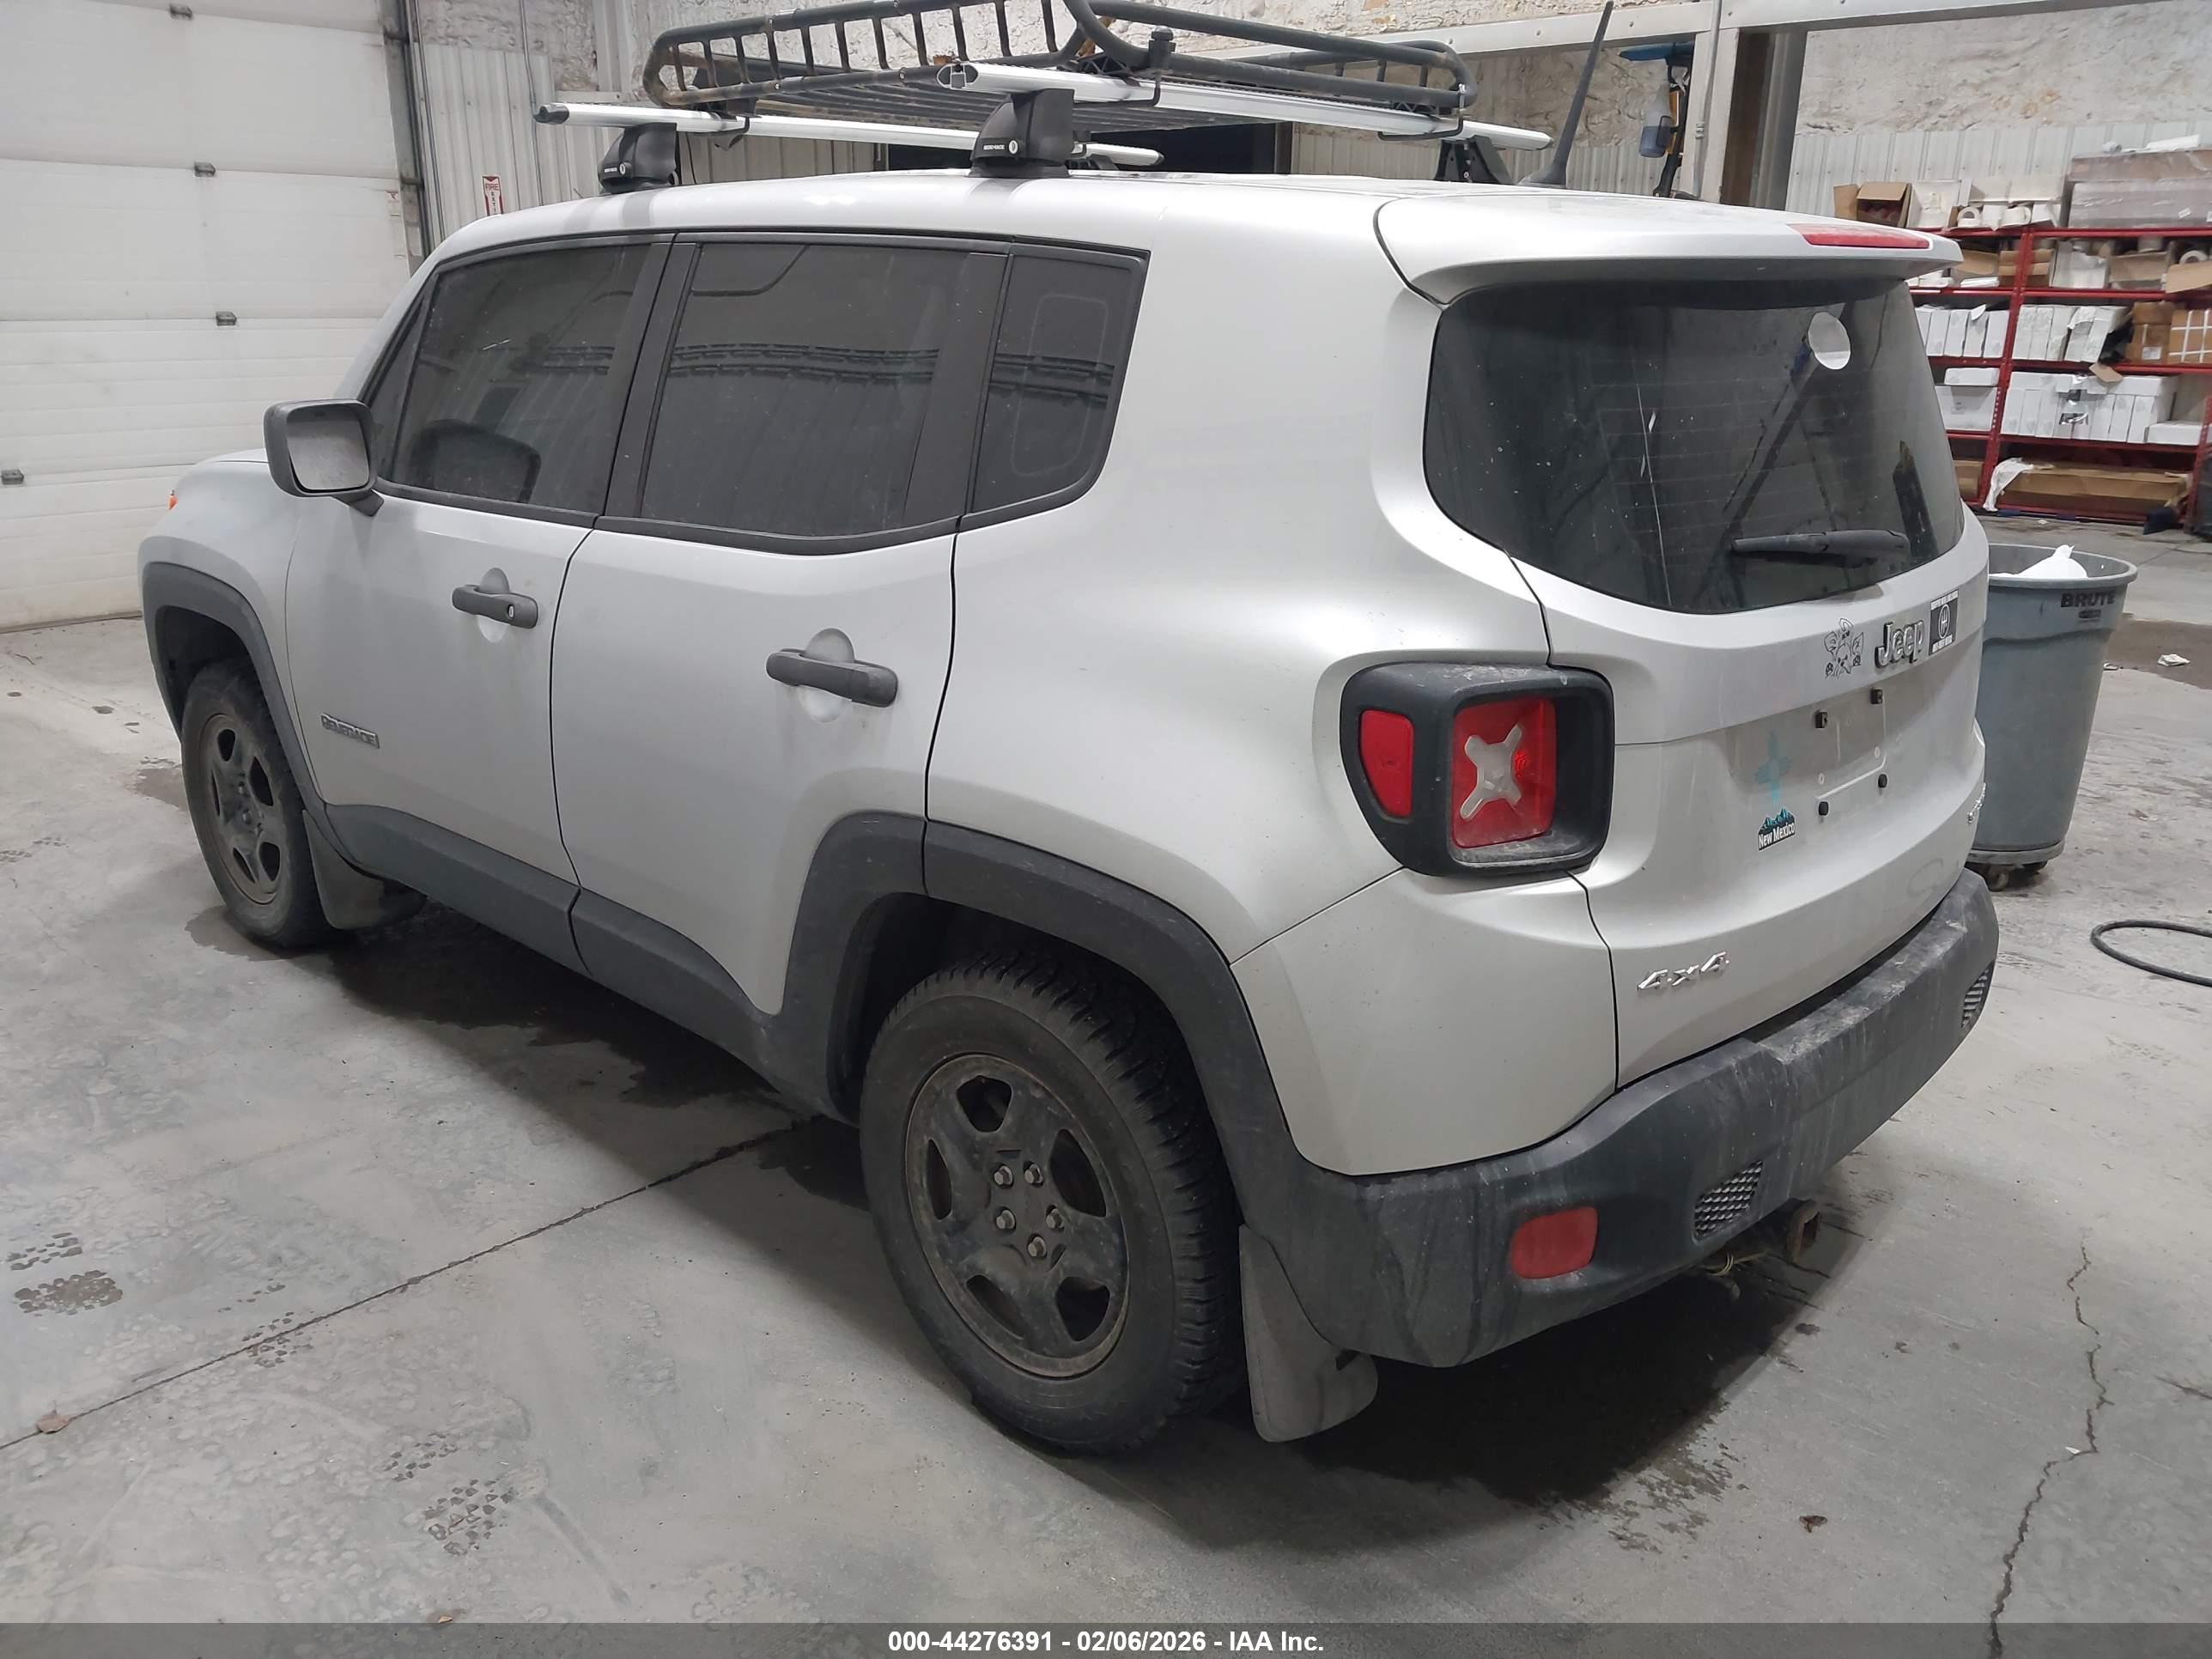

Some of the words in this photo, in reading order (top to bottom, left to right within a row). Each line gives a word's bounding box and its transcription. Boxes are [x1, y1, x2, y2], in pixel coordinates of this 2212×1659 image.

[485, 183, 500, 191] FIRE
[2061, 590, 2116, 608] BRUTE
[1875, 620, 1924, 668] Jeep
[1759, 831, 1773, 848] New
[1773, 822, 1795, 842] Mexico
[1638, 951, 1731, 989] 4x4
